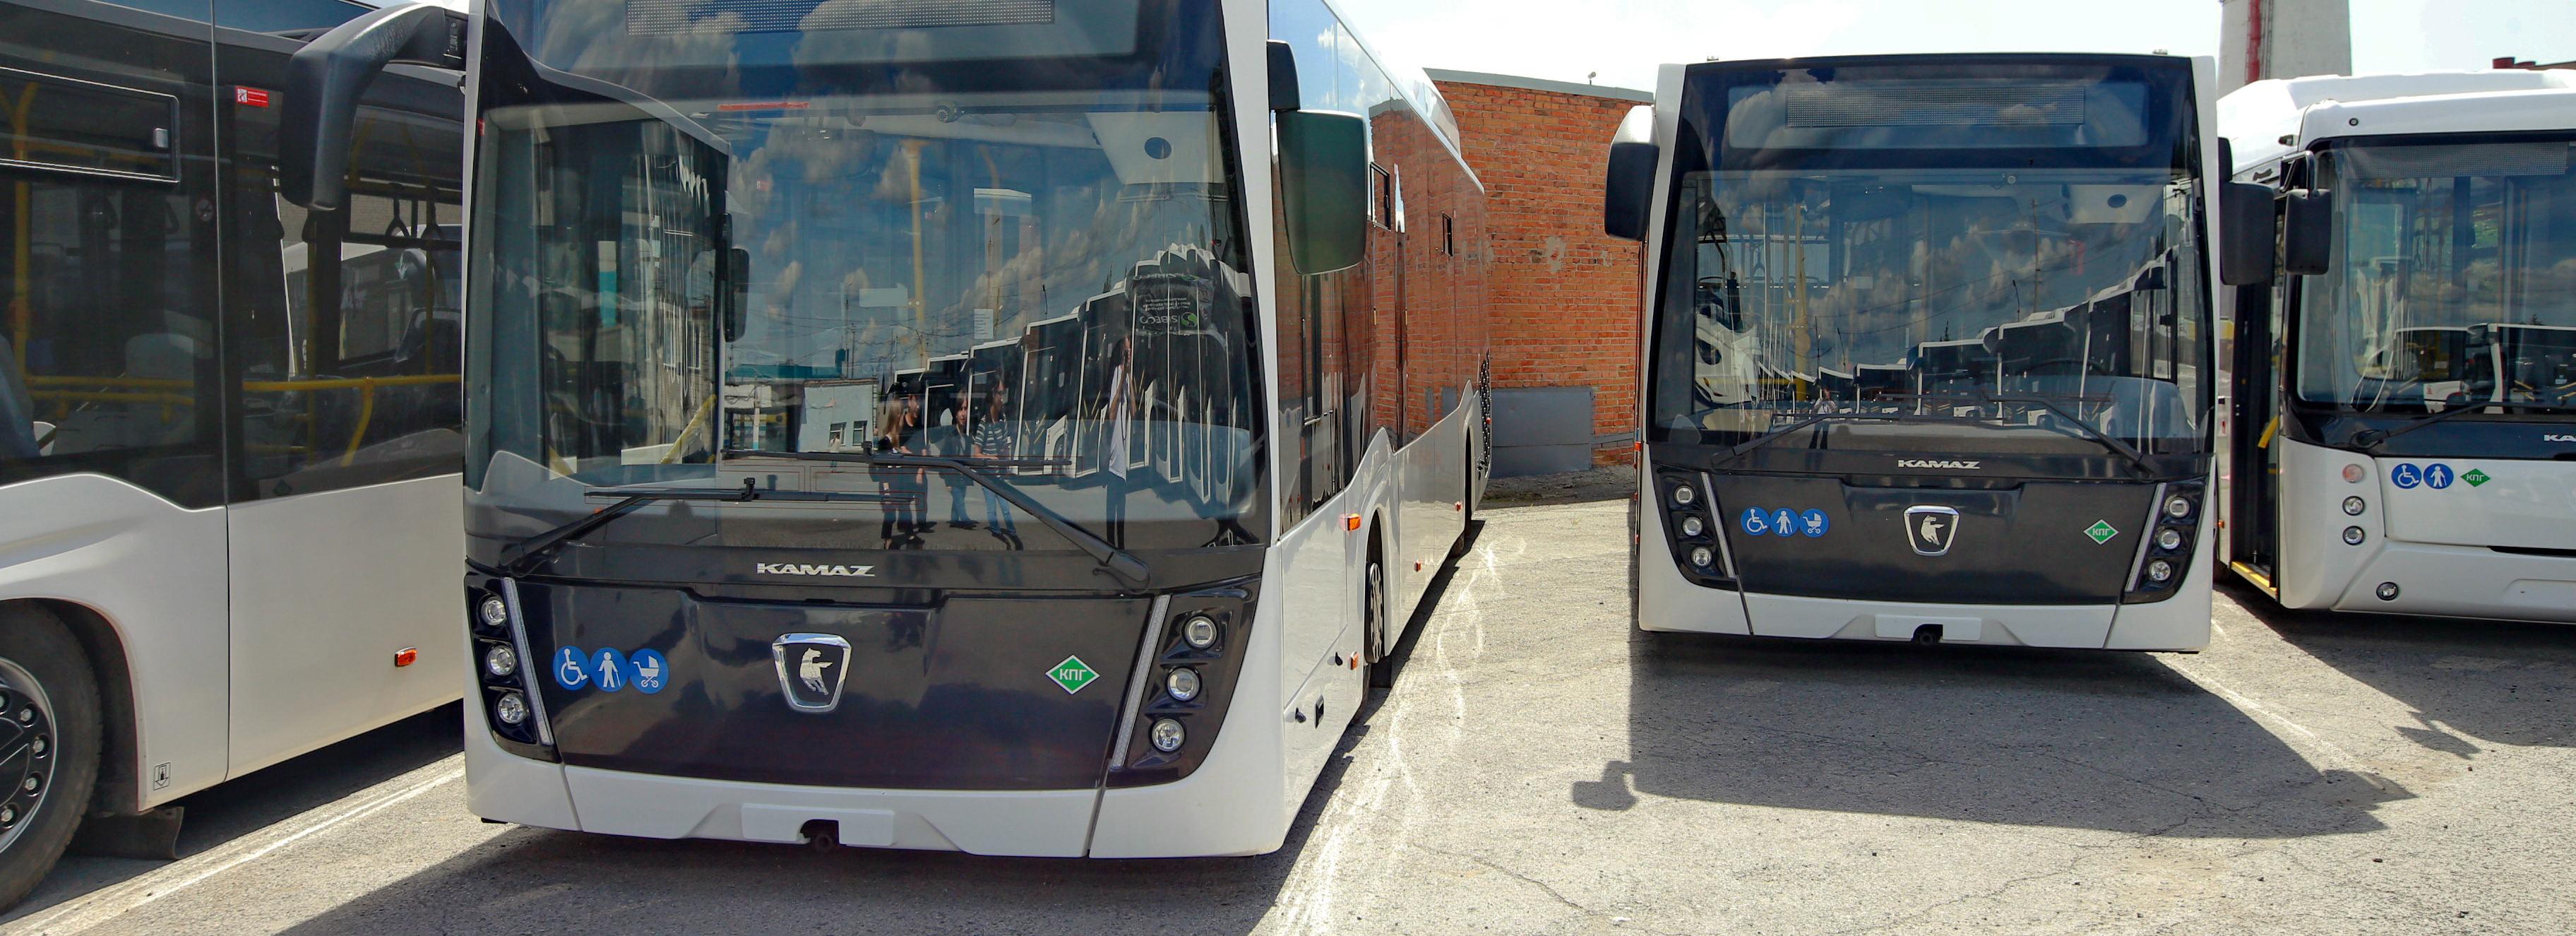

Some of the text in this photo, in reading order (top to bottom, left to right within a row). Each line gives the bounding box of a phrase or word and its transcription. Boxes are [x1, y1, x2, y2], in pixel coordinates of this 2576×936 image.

[1898, 460, 1980, 469] KAMAZ
[757, 563, 875, 576] KAMAZ
[1060, 668, 1087, 680] КПГ
